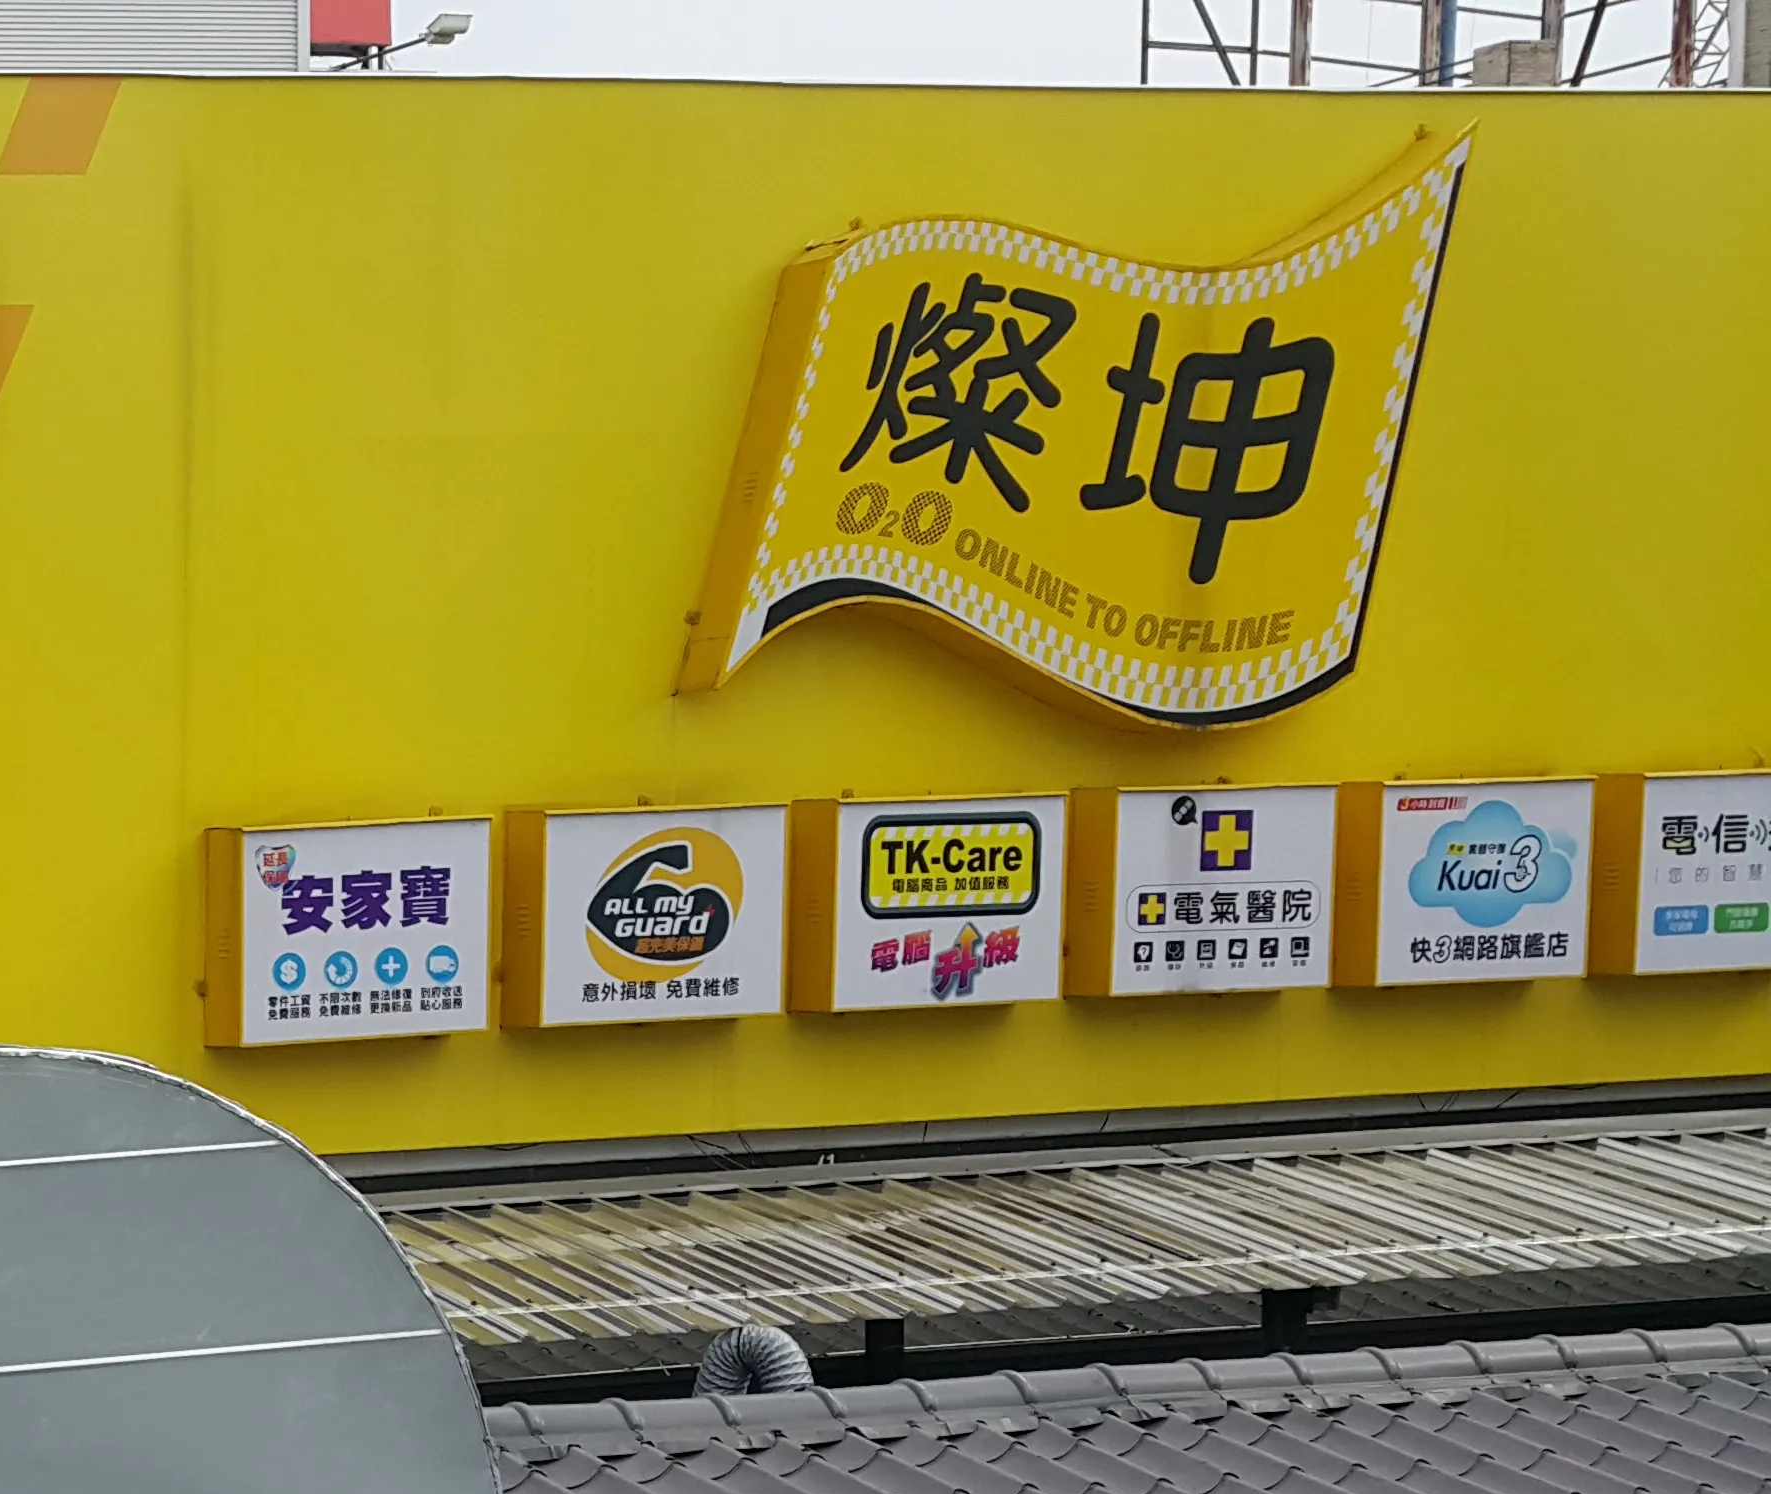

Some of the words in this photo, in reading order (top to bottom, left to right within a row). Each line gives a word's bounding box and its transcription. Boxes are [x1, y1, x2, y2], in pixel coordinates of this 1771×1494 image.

[840, 272, 1336, 585] 燦坤
[835, 482, 953, 547] O2O
[954, 527, 1080, 619] ONLINE
[1086, 596, 1127, 640] TO
[1134, 610, 1295, 654] OFFLINE
[1662, 813, 1771, 855] 電信
[881, 838, 1022, 875] TK-Care
[281, 866, 451, 935] 安家寶
[893, 877, 947, 893] 電腦商品
[954, 876, 1009, 891] 加值服務
[604, 898, 649, 915] ALL
[1174, 889, 1312, 925] 電氣醫院
[871, 922, 1021, 996] 電腦升級
[1410, 931, 1569, 964] 快3網路旗艦店
[582, 981, 656, 1002] 意外損壞
[666, 977, 740, 999] 免費維修
